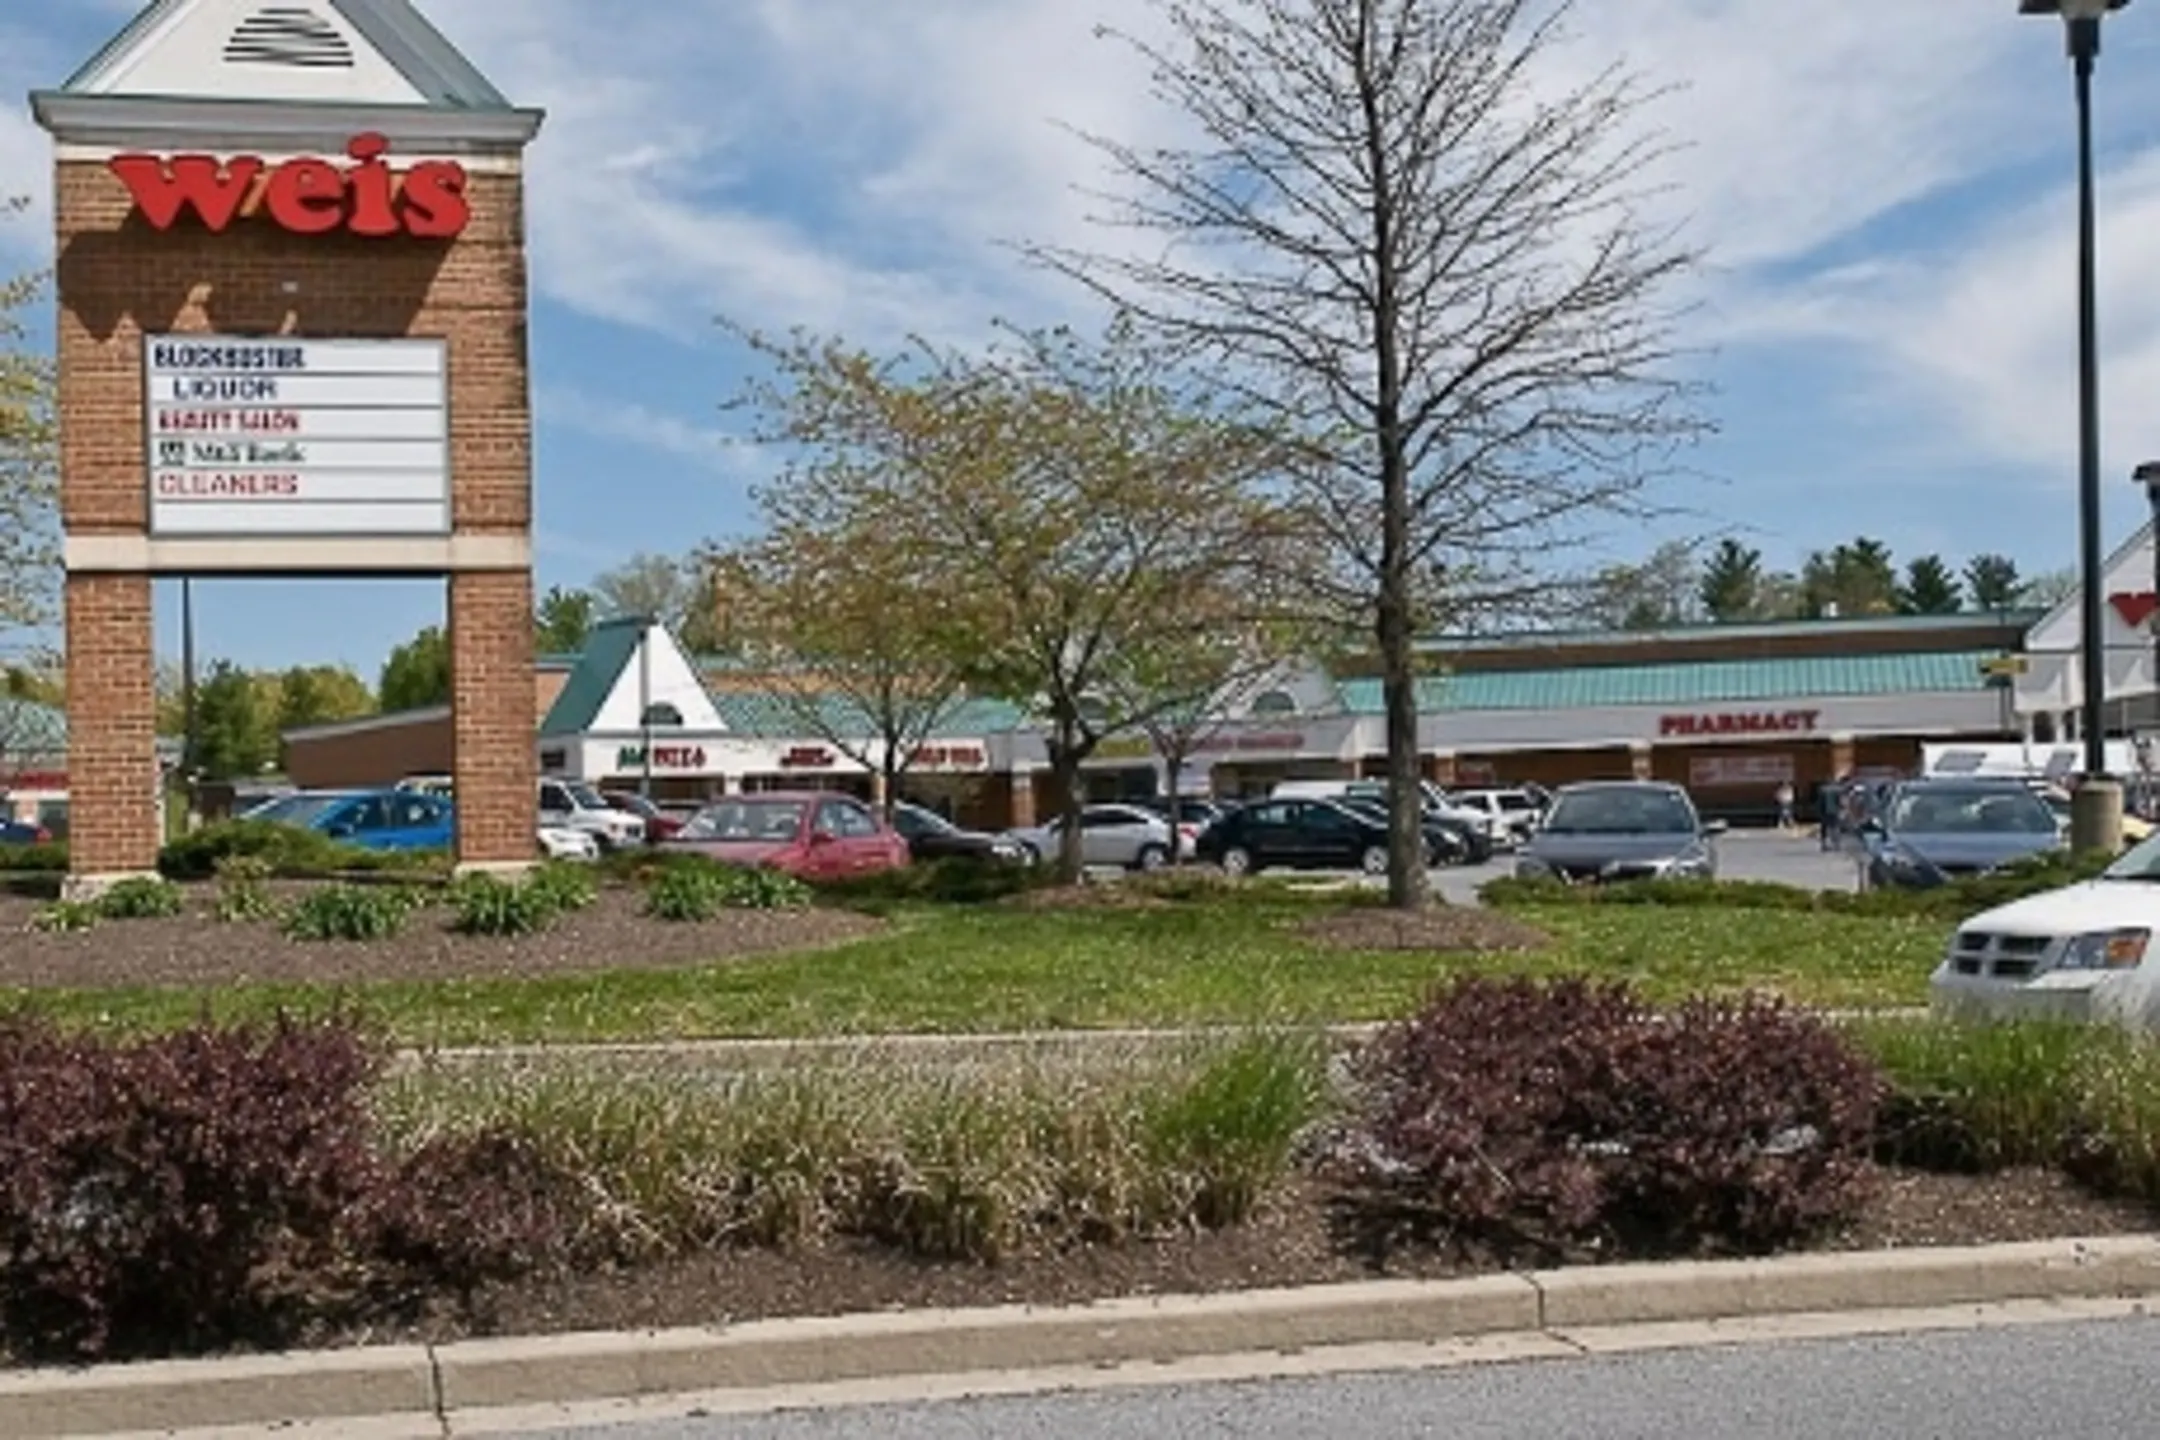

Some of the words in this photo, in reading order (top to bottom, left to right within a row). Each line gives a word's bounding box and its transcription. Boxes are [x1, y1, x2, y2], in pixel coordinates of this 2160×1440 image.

[110, 132, 471, 237] weis
[173, 379, 278, 401] LIQUOR
[159, 475, 299, 495] CLEANERS
[1659, 710, 1821, 736] PHARMACY
